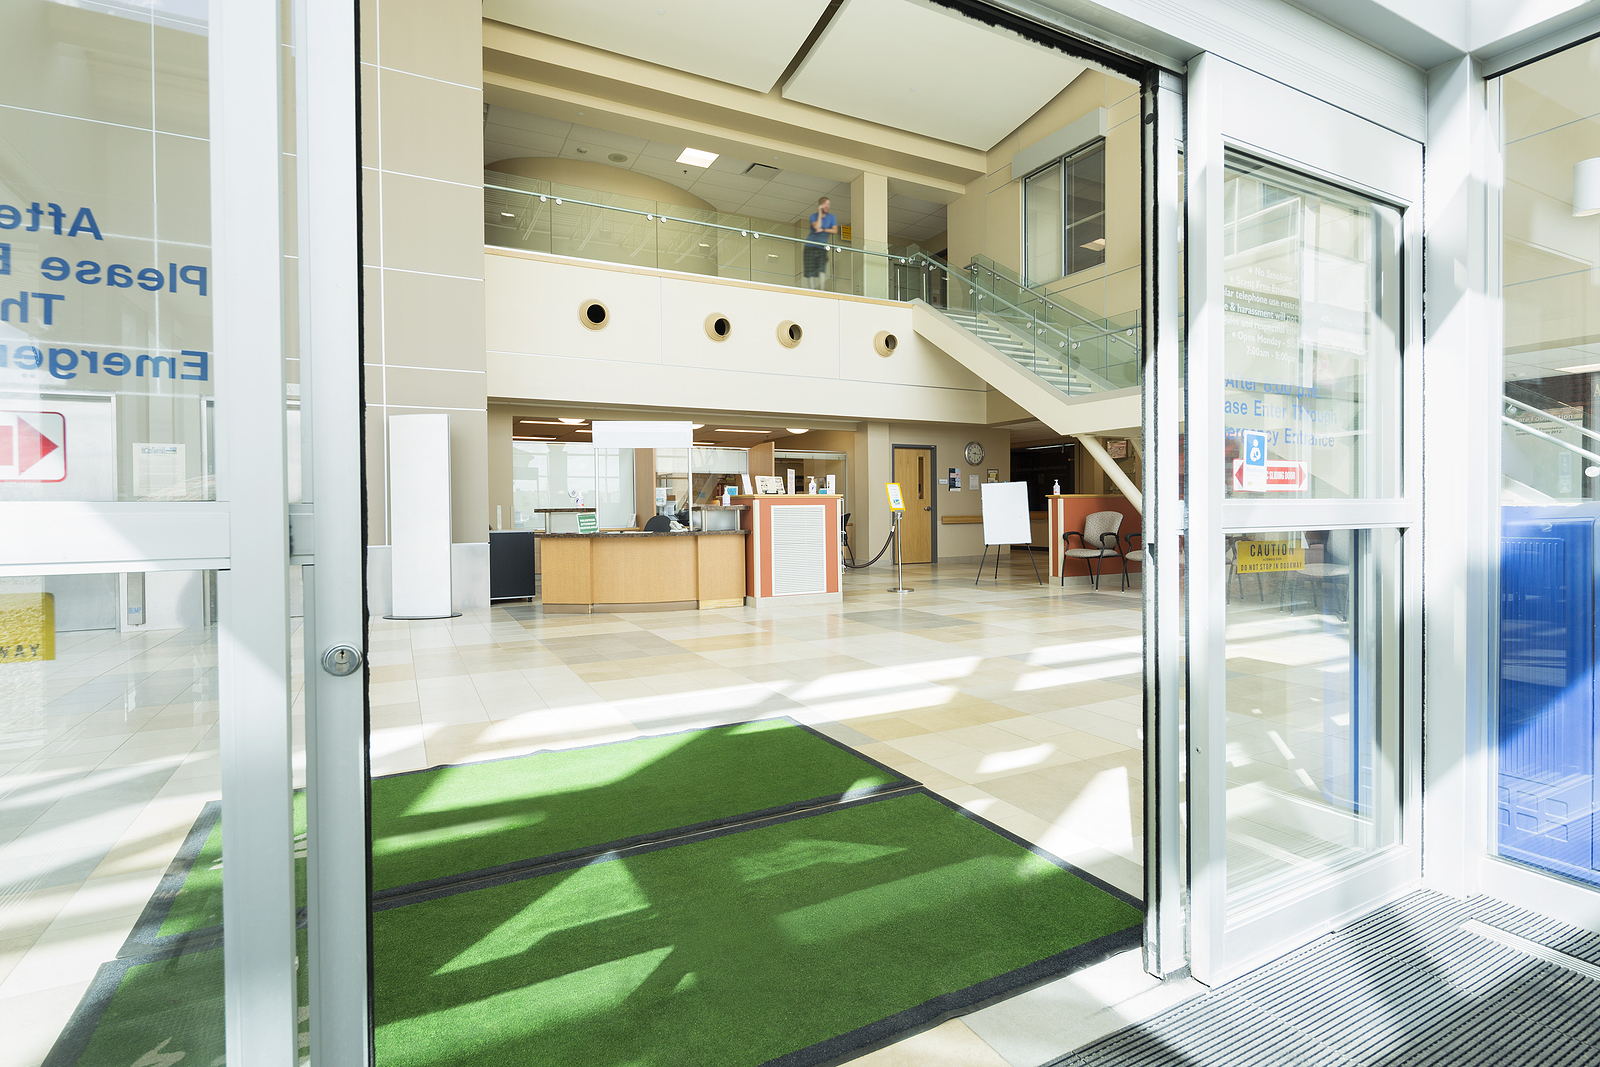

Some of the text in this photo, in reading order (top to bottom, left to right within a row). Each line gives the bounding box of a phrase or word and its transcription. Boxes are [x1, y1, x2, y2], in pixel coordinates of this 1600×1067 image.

[1236, 276, 1255, 288] Scent
[1256, 280, 1270, 292] Free
[1255, 267, 1292, 285] No Smoking
[1236, 291, 1268, 304] telephone
[1230, 302, 1236, 311] &
[1237, 304, 1274, 318] harassment
[1275, 311, 1286, 320] will
[1254, 324, 1284, 334] respectful
[1237, 331, 1255, 343] Open
[1257, 334, 1281, 348] Monday
[1246, 346, 1269, 358] 7:00am
[1275, 351, 1298, 364] 8:00pm
[1225, 371, 1321, 399] After 8:00 p.m.
[1254, 400, 1287, 419] Enter
[1292, 404, 1337, 427] Through
[1225, 426, 1335, 447] ergcy Entrance
[1250, 544, 1294, 557] CAUTION
